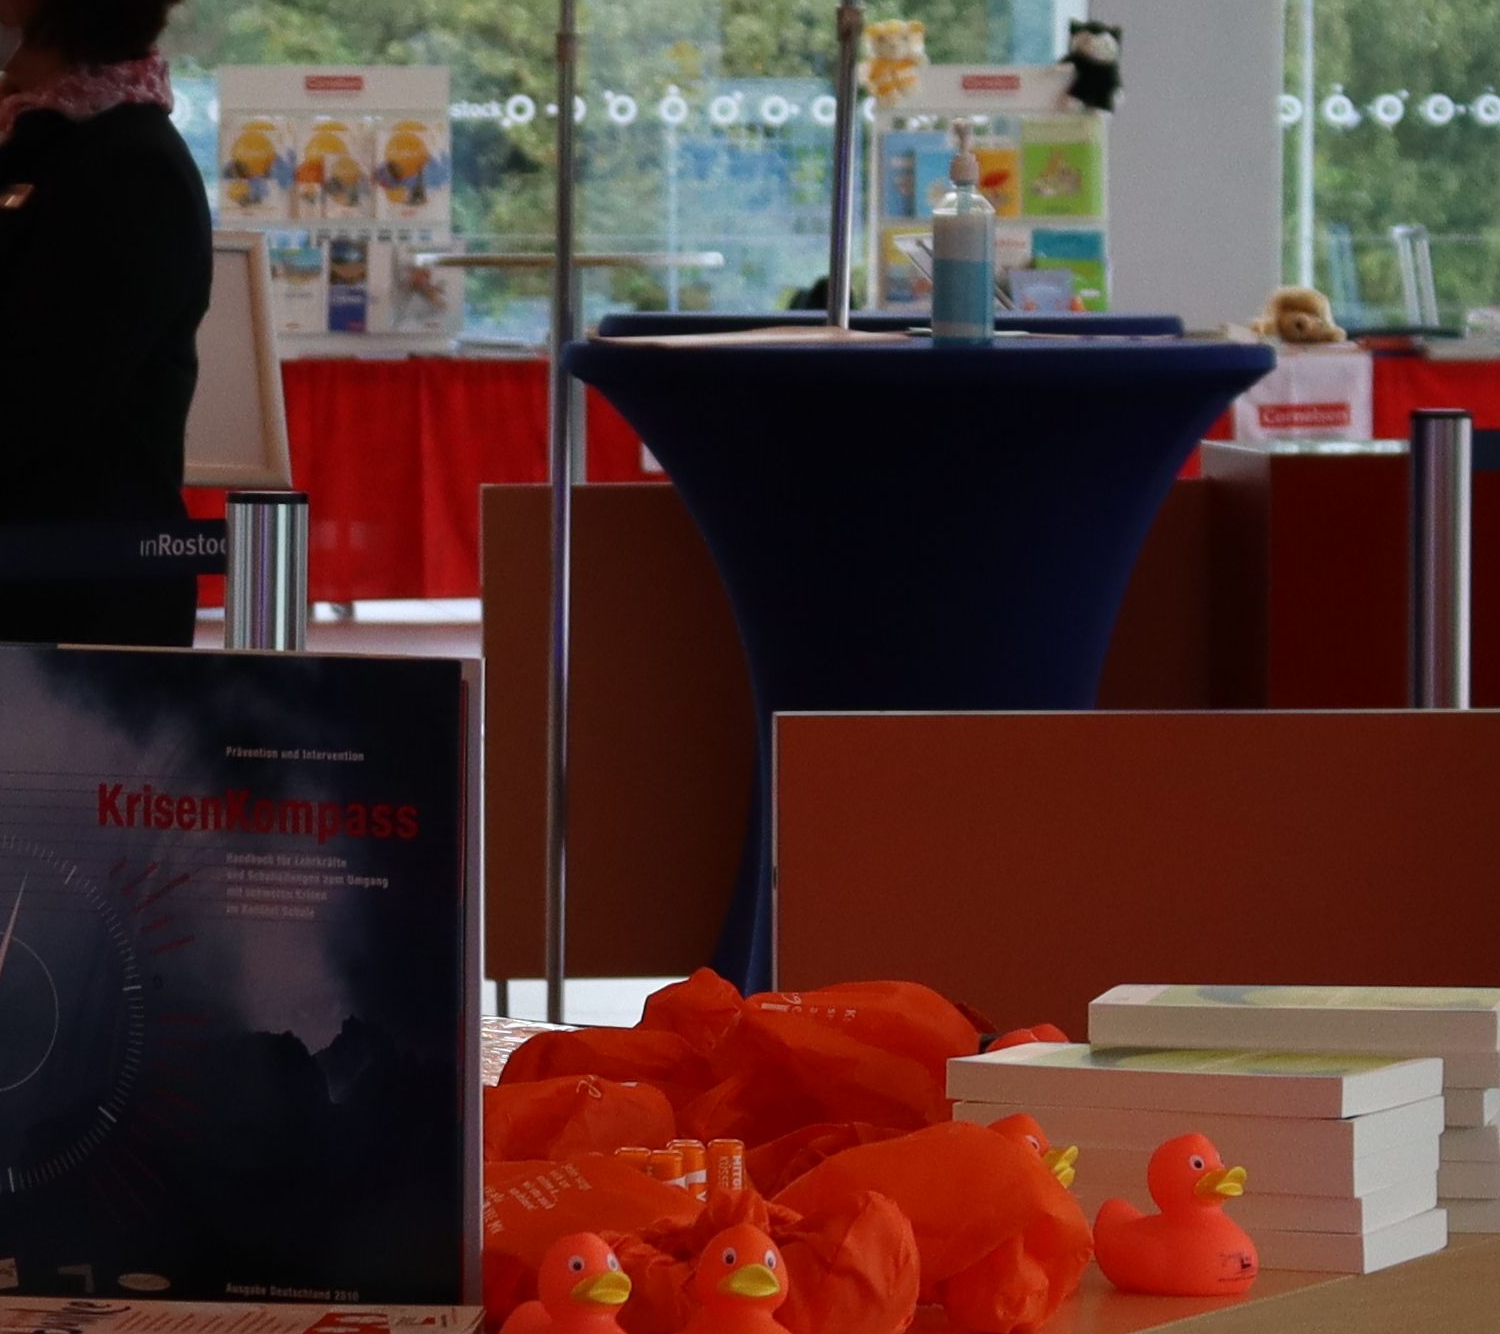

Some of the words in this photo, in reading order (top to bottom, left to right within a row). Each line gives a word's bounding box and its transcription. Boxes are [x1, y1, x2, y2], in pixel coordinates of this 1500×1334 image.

[281, 748, 300, 760] und
[302, 749, 365, 763] Intervention
[97, 782, 421, 843] KrisenKompass
